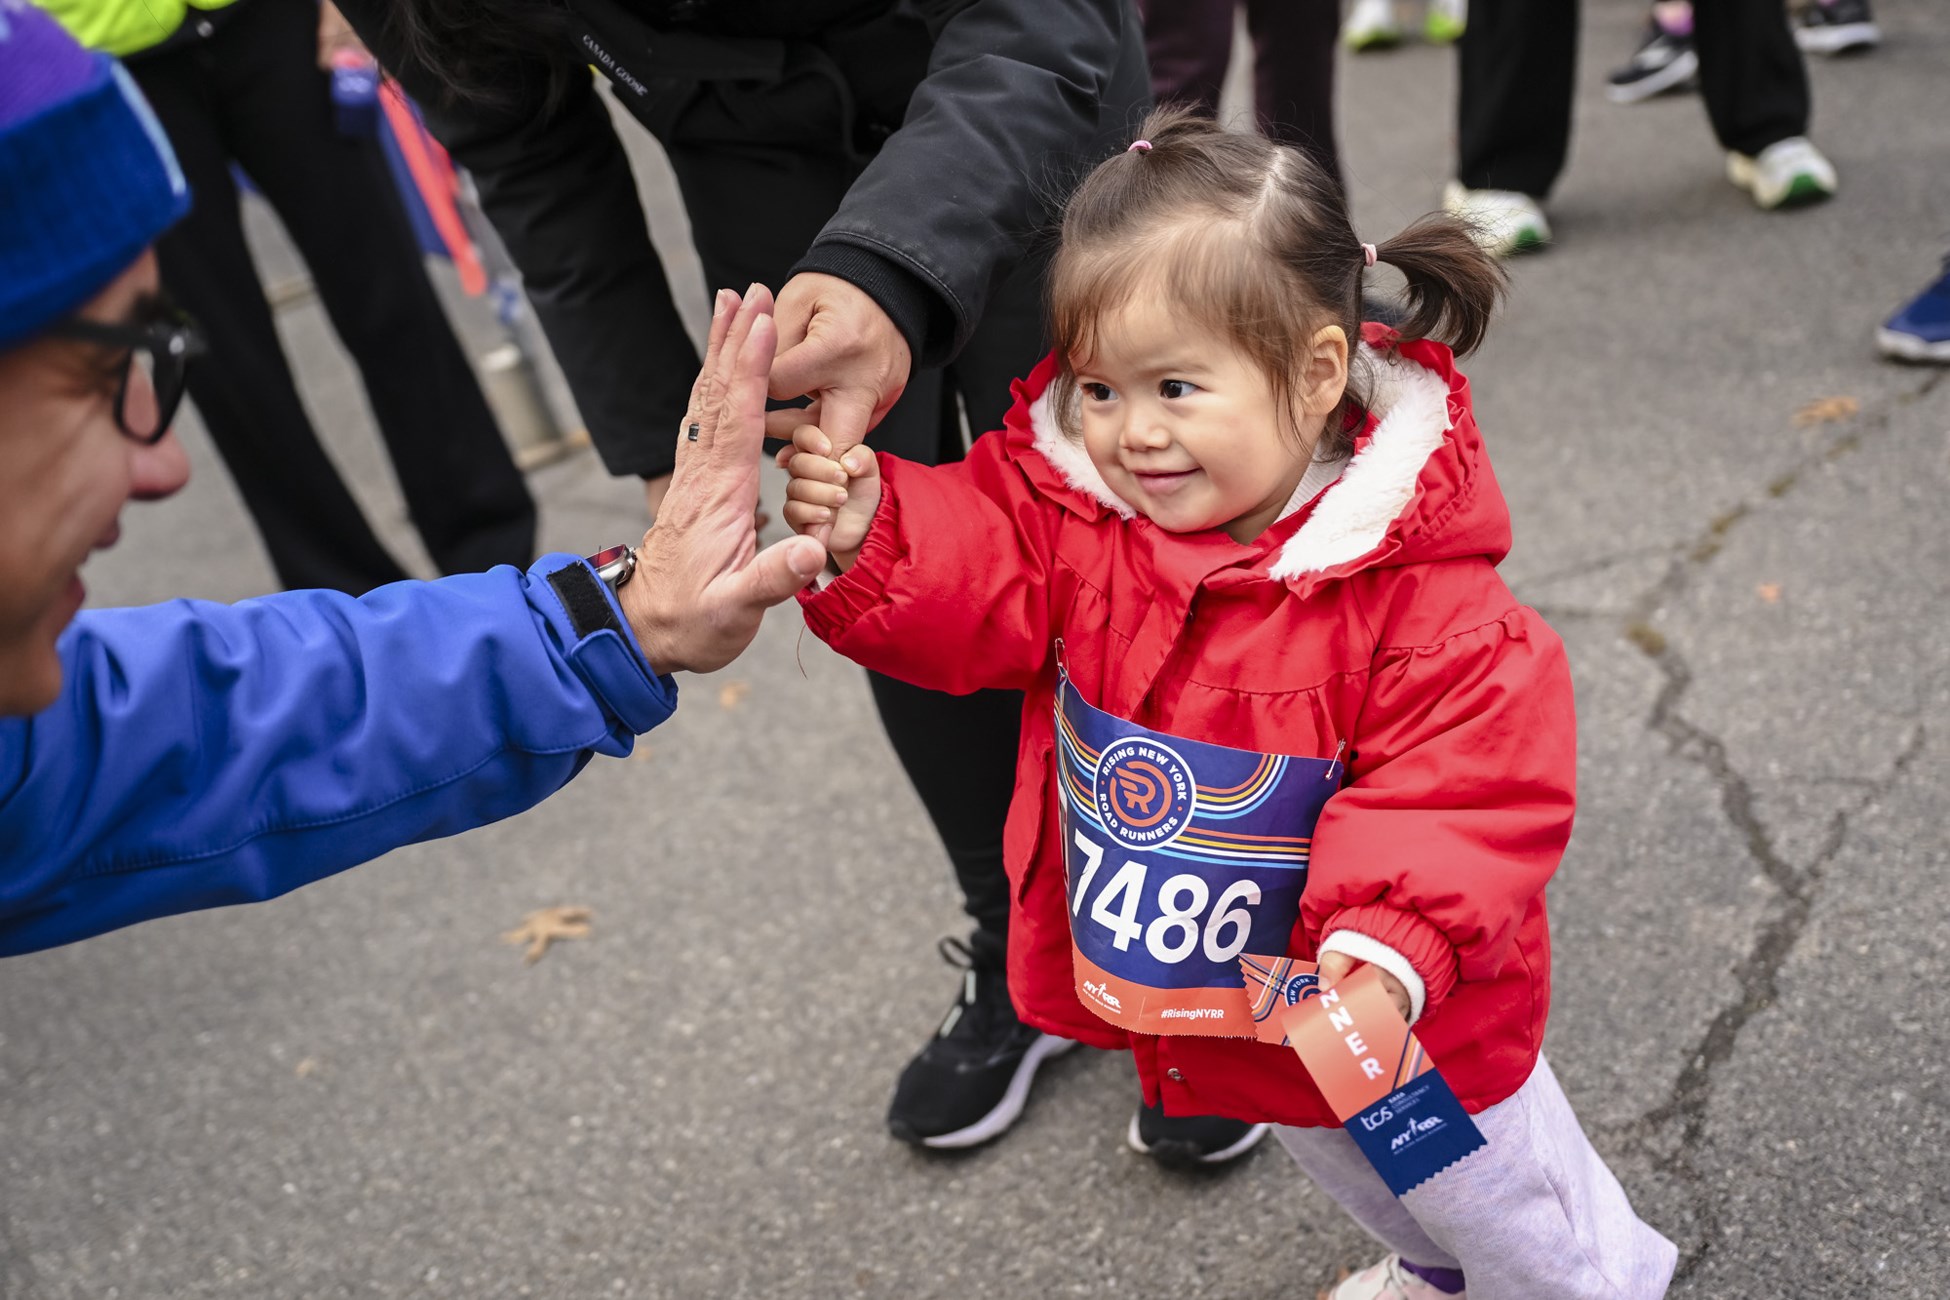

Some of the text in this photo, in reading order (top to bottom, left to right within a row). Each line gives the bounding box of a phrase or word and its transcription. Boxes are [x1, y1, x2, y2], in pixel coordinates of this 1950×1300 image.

[583, 34, 648, 96] CANADA GOOSE
[1102, 746, 1187, 801] RISING NEW YORK
[1099, 793, 1179, 841] ROAD RUNNERS
[1072, 828, 1262, 964] 7486
[1292, 977, 1310, 989] YORK
[1160, 1008, 1225, 1020] #RisingNYRR
[1319, 988, 1385, 1081] NNER
